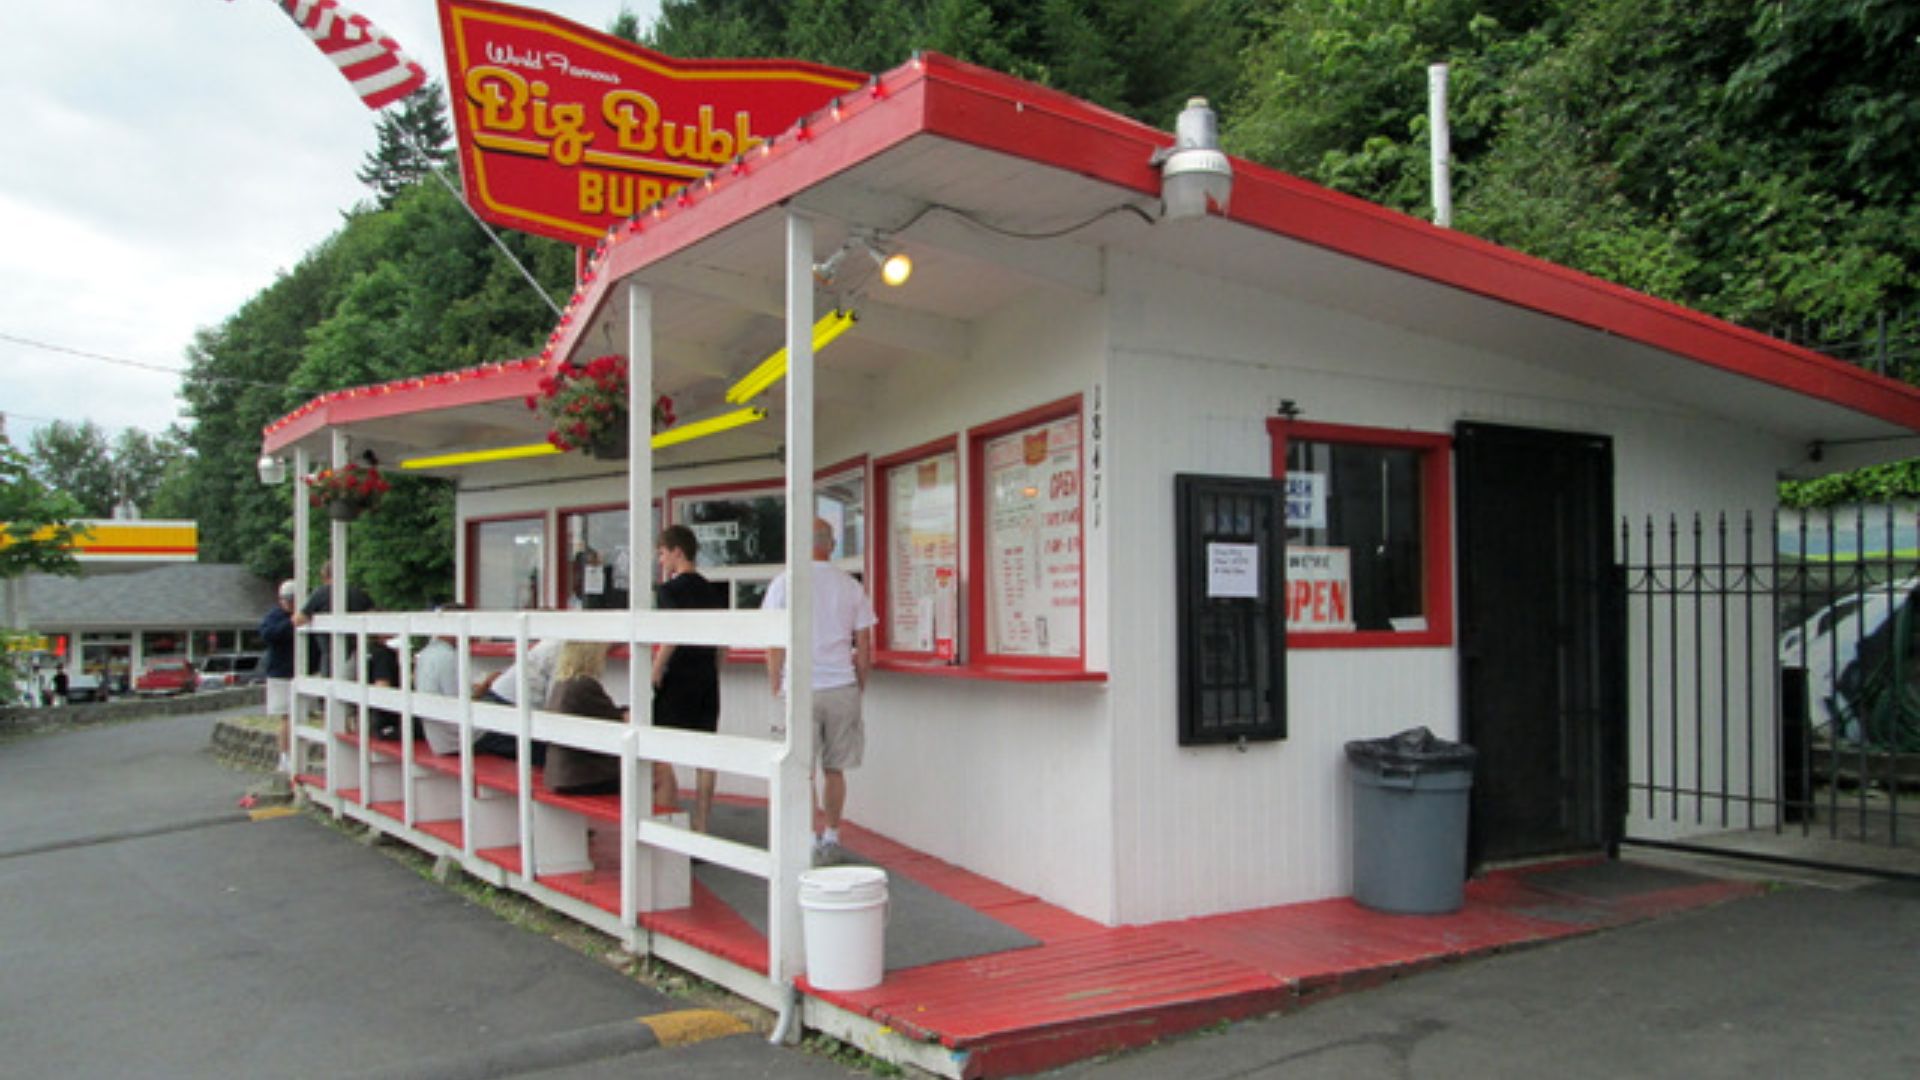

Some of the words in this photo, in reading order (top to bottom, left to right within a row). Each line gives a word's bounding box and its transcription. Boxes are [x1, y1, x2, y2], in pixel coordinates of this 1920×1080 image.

[485, 41, 543, 70] World
[546, 52, 622, 84] Famous
[465, 66, 594, 166] Big
[579, 170, 683, 218] BUR
